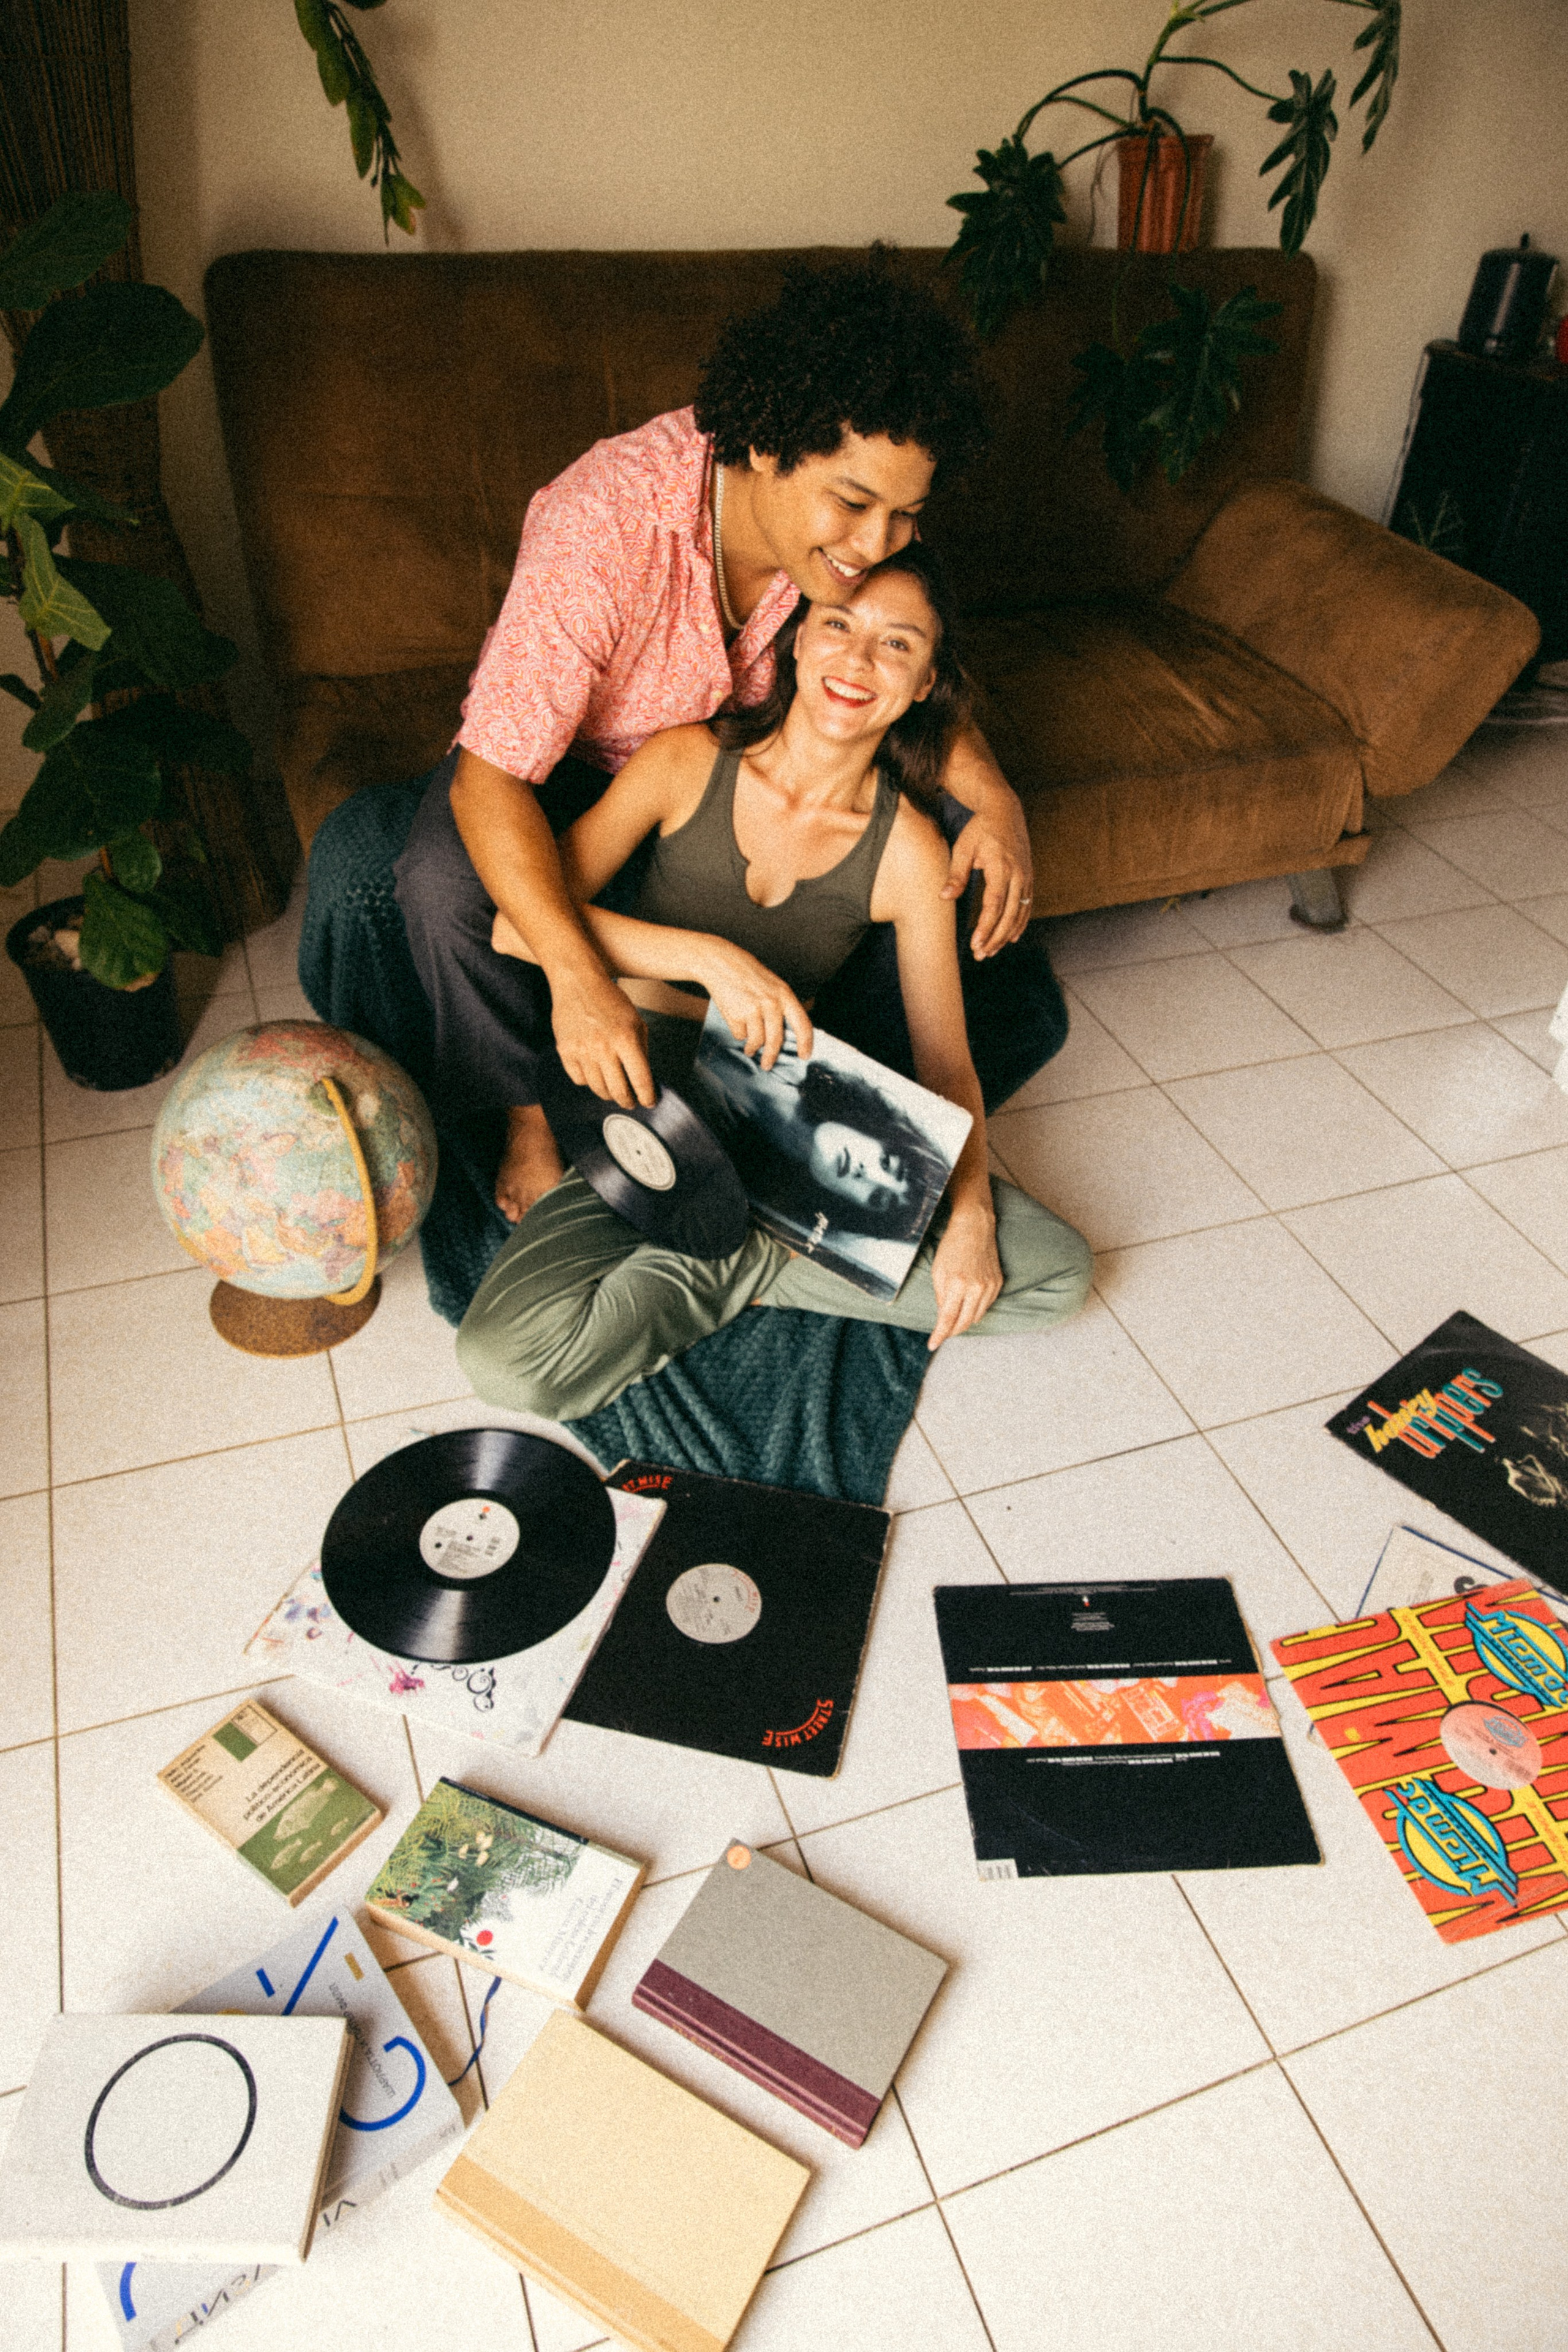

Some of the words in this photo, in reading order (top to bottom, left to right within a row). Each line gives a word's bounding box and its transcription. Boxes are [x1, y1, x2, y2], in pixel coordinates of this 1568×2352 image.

[1347, 1415, 1371, 1435] the
[638, 1474, 673, 1490] WISE
[761, 1729, 802, 1747] WISE
[1395, 1780, 1518, 1909] Micmac
